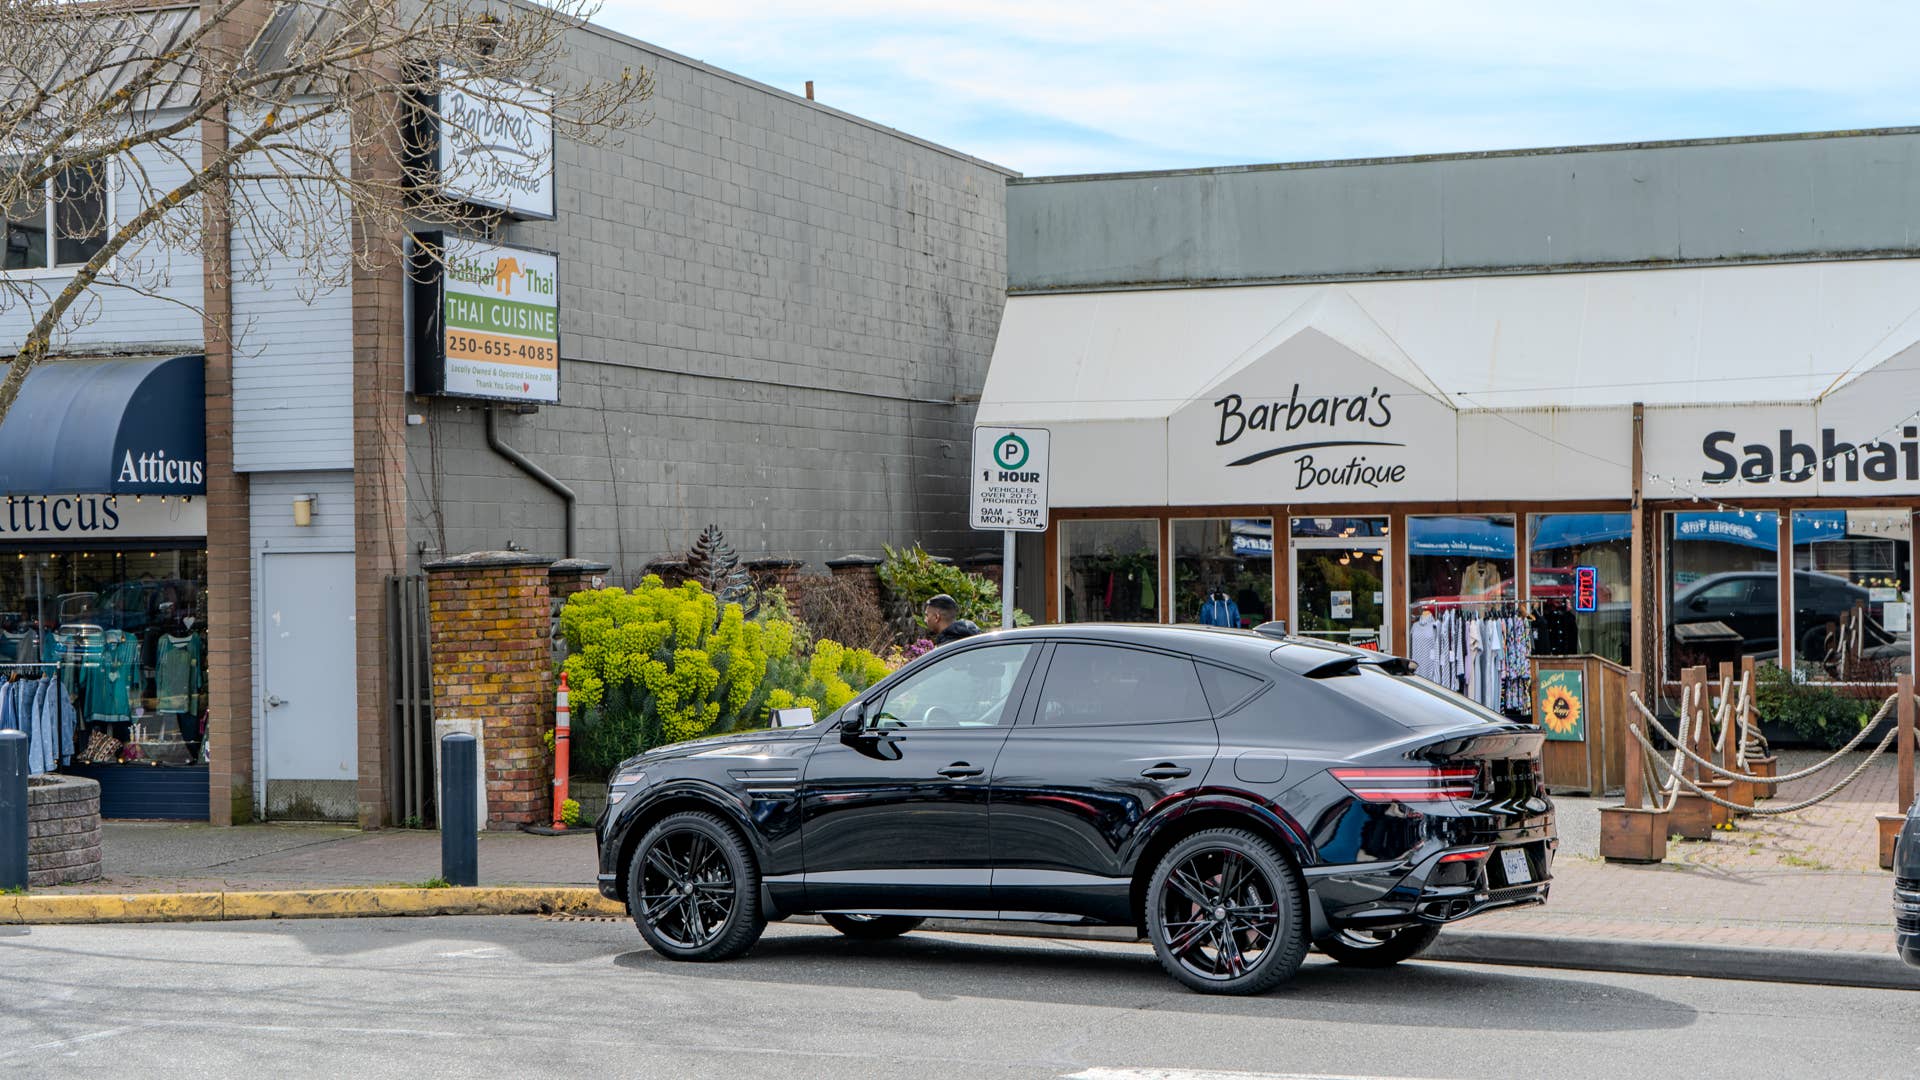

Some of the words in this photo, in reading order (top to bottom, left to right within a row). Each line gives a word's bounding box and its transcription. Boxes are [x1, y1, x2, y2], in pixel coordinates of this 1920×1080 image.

[450, 93, 533, 148] Barbara's
[490, 156, 540, 195] Boutique
[526, 268, 553, 295] Thai
[448, 298, 484, 323] THAI
[491, 305, 554, 333] CUISINE
[449, 336, 553, 361] 250-655-4085
[451, 364, 470, 375] Locally
[472, 366, 492, 376] Owned
[499, 369, 523, 379] Operated
[524, 371, 538, 380] Since
[475, 379, 493, 388] Thank
[494, 381, 503, 390] You
[505, 382, 523, 393] Sidney
[1214, 383, 1392, 446] Barbara's
[118, 449, 203, 484] Atticus
[1005, 444, 1018, 460] P
[1701, 426, 1919, 484] Sabhai
[983, 470, 989, 481] 1
[998, 471, 1040, 483] HOUR
[1294, 455, 1405, 490] Boutique
[0, 495, 119, 532] tticus
[981, 508, 1003, 516] 9AM
[981, 516, 1004, 524] MON
[1019, 517, 1038, 525] SAT
